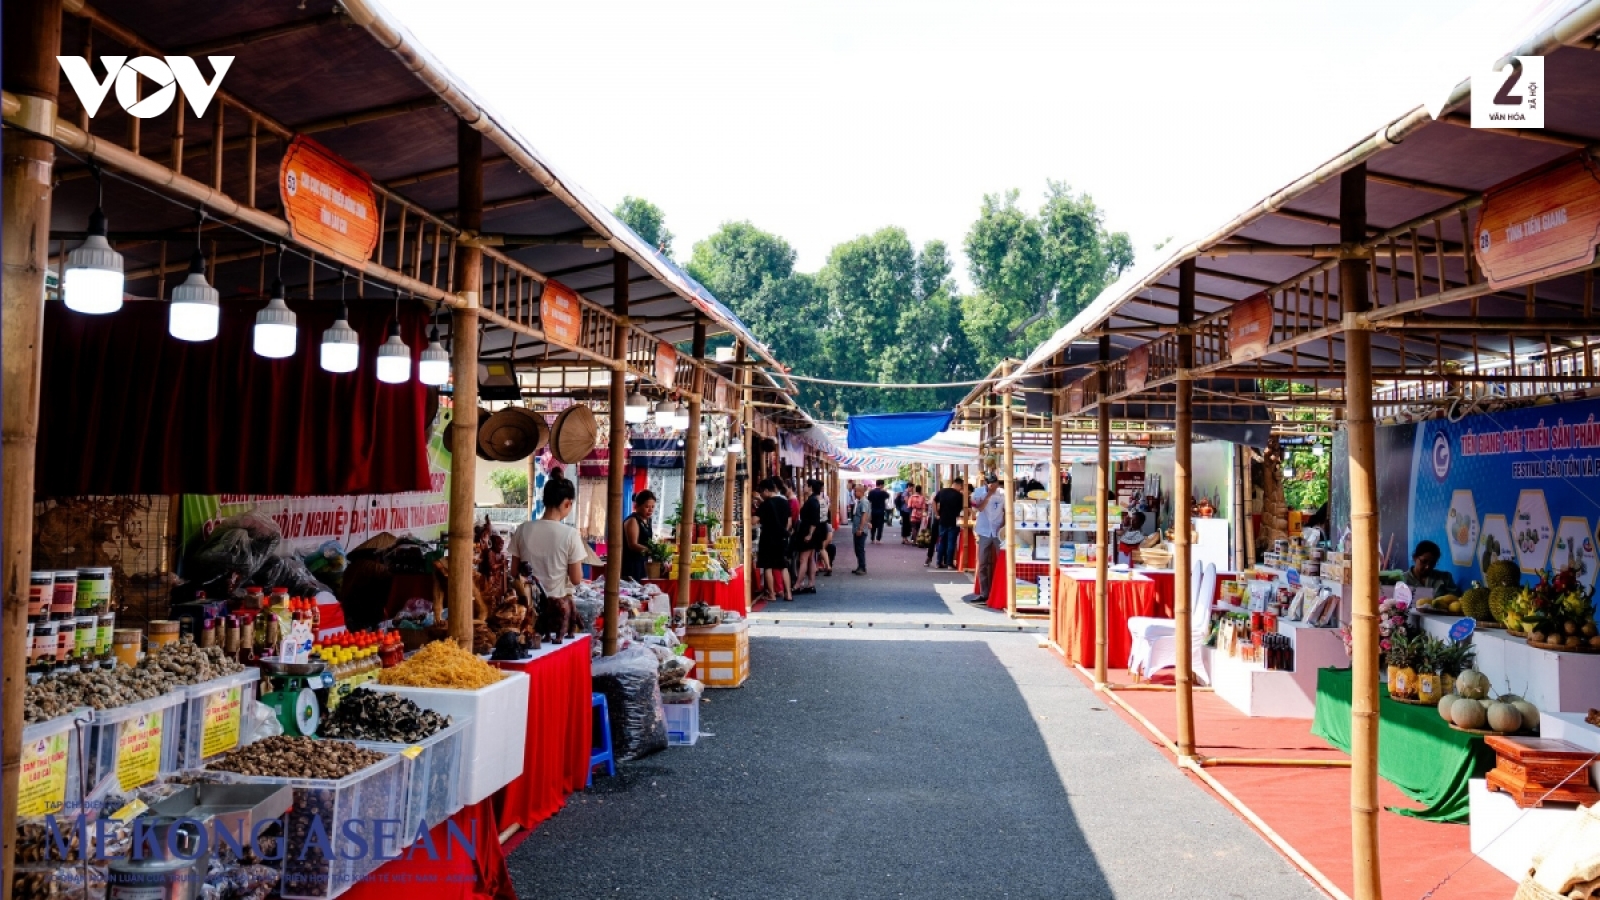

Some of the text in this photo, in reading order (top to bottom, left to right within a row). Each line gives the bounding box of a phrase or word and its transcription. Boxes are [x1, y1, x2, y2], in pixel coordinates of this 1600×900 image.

[1542, 208, 1568, 231] GIANG
[1481, 235, 1489, 248] 28
[1479, 431, 1500, 455] GIANG
[1503, 425, 1523, 454] PHÁT
[1525, 418, 1549, 452] TRIỂN
[1552, 417, 1571, 449] SẢN
[1512, 460, 1544, 478] FESTIVAL
[1546, 455, 1562, 478] BẢO
[1582, 455, 1593, 477] VÀ
[304, 505, 348, 540] NGHIỆP
